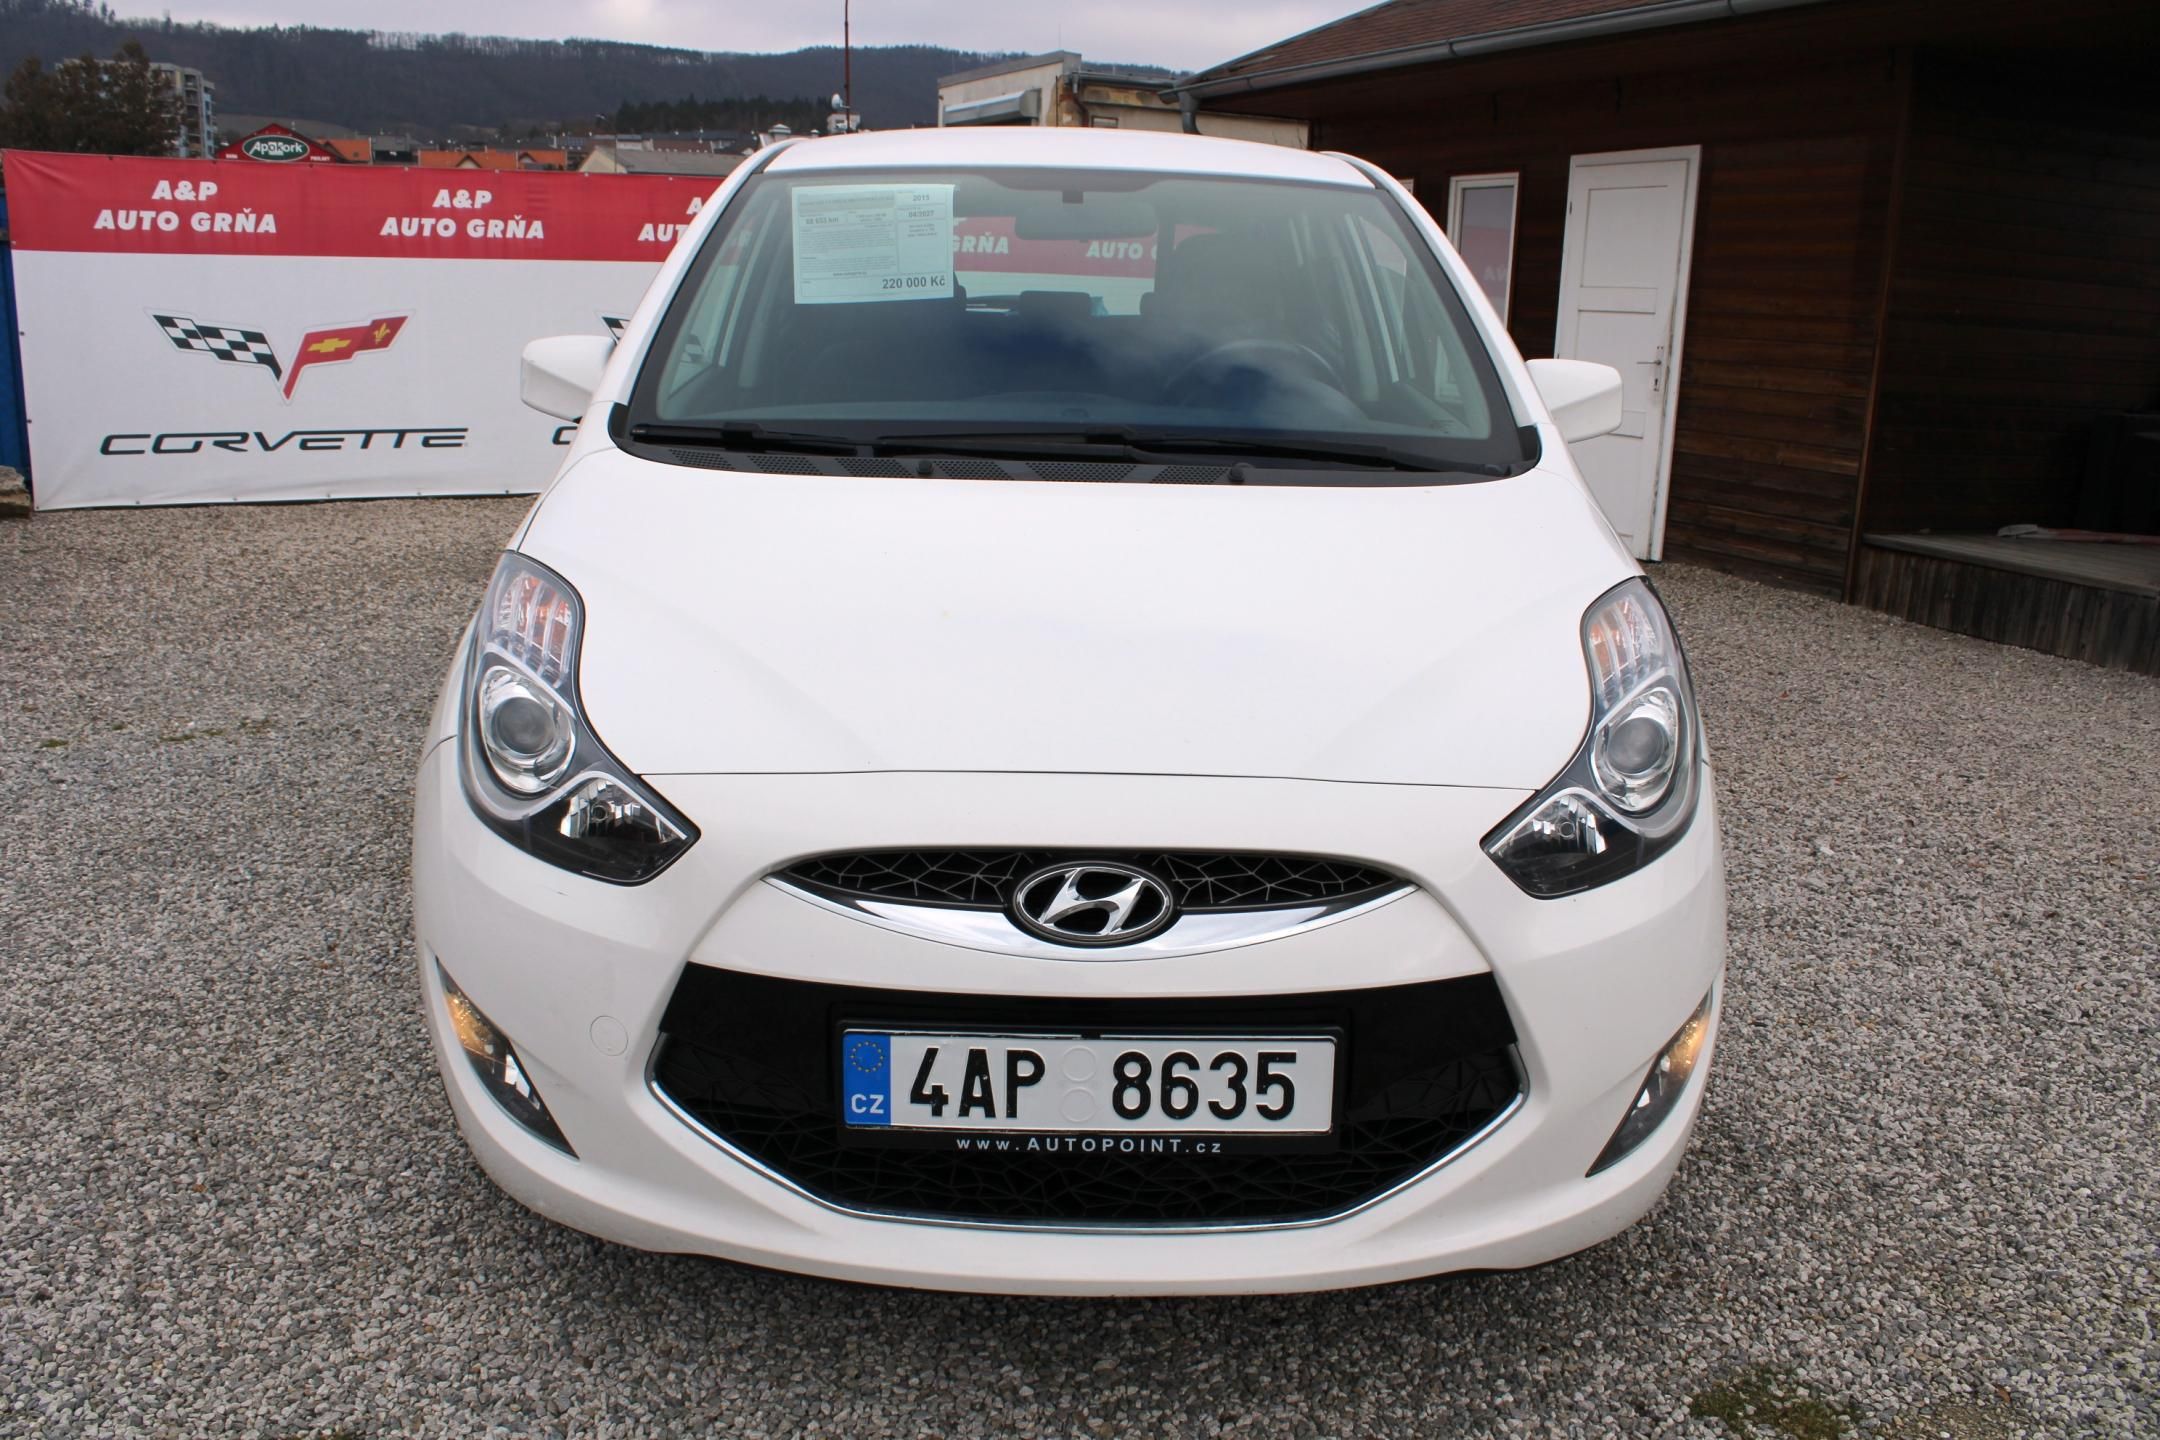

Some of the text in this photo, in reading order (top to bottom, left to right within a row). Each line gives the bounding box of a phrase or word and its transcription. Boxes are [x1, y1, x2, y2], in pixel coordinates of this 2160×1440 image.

[151, 179, 218, 201] A&P
[432, 188, 493, 209] A&P
[93, 207, 277, 233] AUTO GRŇA
[379, 214, 545, 239] AUTO GRŇA
[637, 223, 690, 242] AUT
[1086, 240, 1143, 260] AUTO
[882, 275, 946, 289] 220 000 Kč
[100, 428, 469, 456] CORVETTE
[851, 1047, 1298, 1121] CZ 4AP 8635
